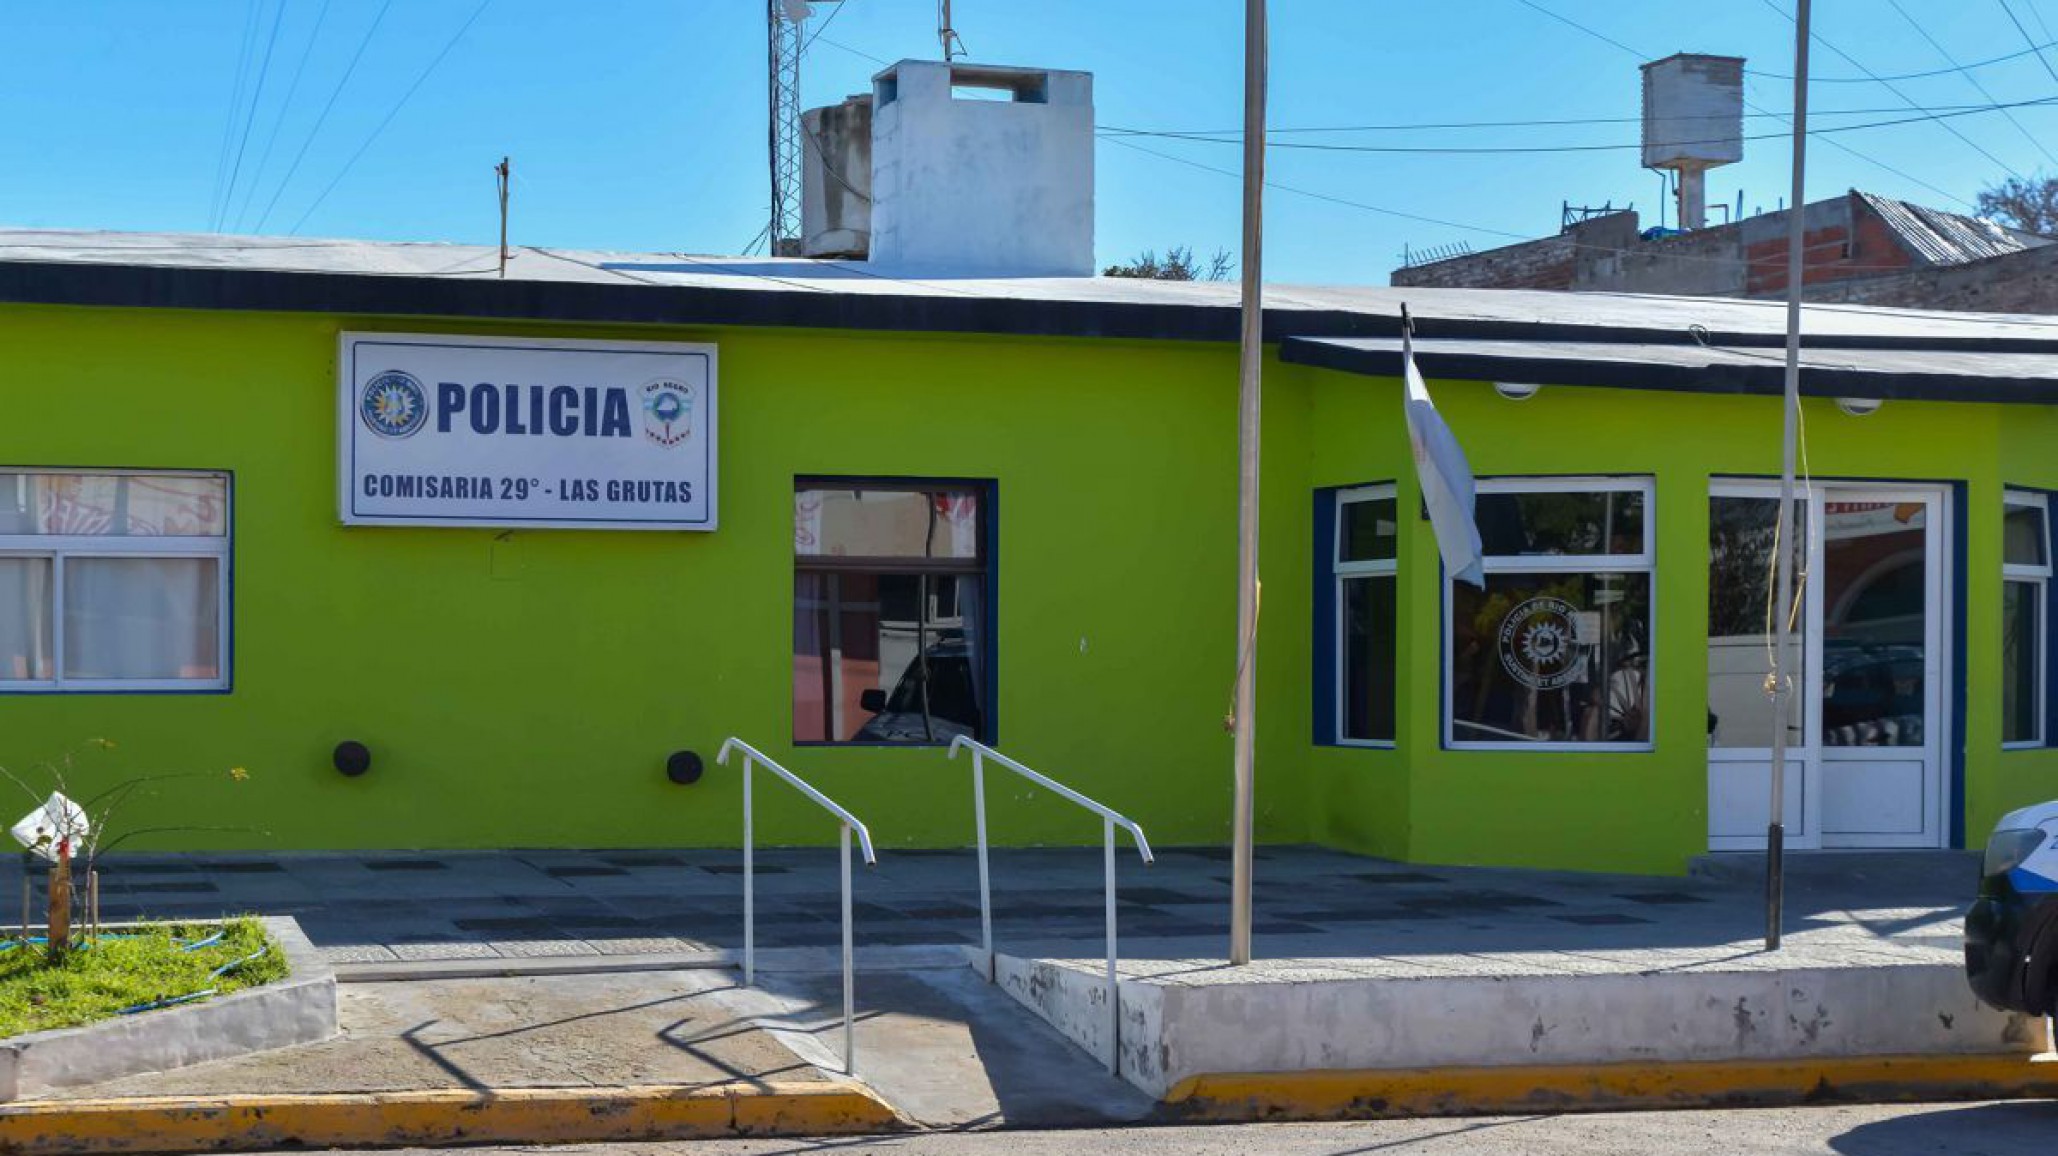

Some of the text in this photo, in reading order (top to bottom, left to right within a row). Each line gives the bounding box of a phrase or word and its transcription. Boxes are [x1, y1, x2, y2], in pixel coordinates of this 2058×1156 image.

[436, 381, 632, 438] POLICIA
[363, 473, 494, 500] COMISARIA
[500, 476, 540, 501] 29°
[559, 478, 600, 502] LAS
[606, 479, 693, 504] GRUTAS
